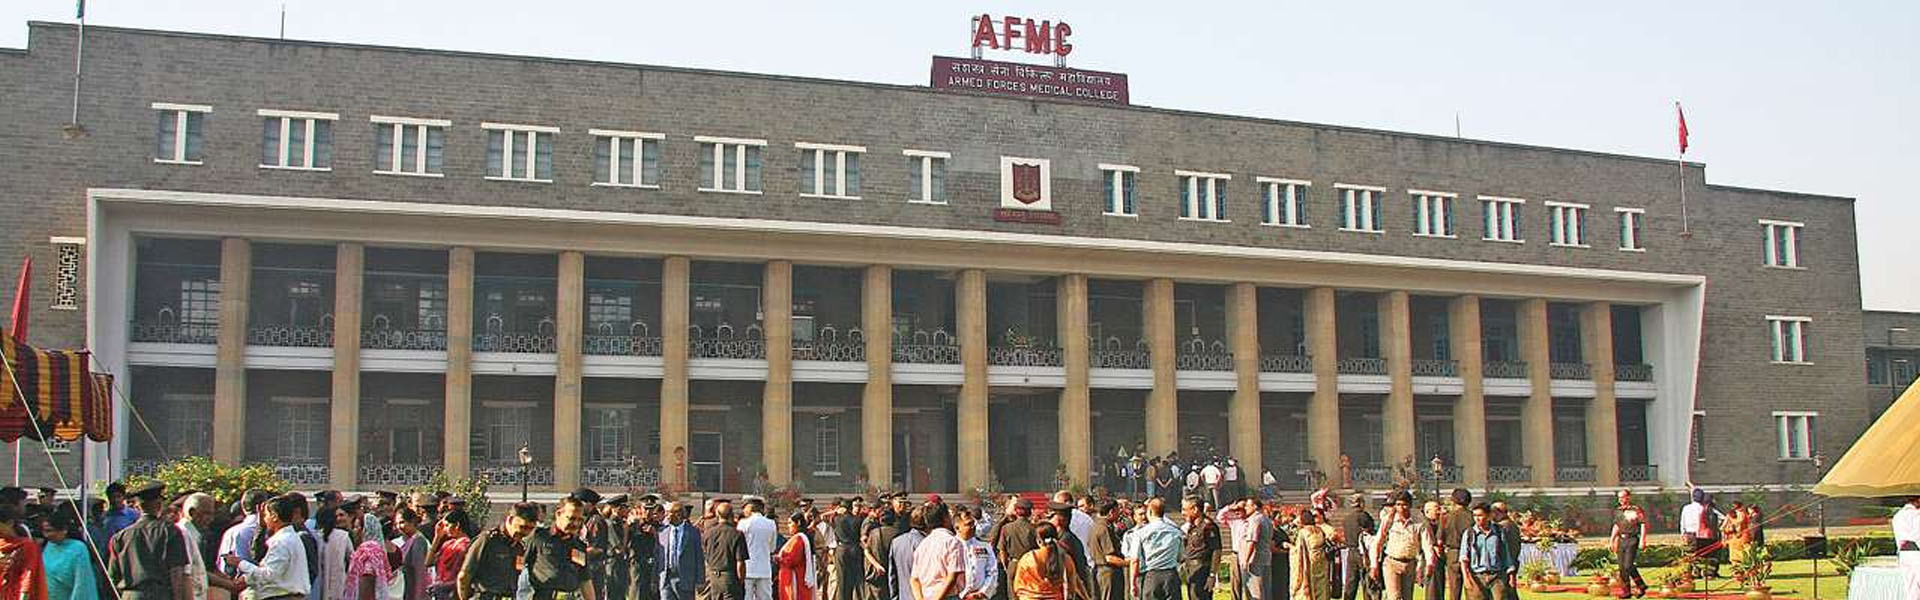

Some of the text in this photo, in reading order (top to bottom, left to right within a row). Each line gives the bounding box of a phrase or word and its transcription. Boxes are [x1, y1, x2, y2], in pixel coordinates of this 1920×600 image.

[972, 13, 1073, 56] AFMC
[948, 76, 1119, 101] ARMED FORCES MEDICAL COLLEGE
